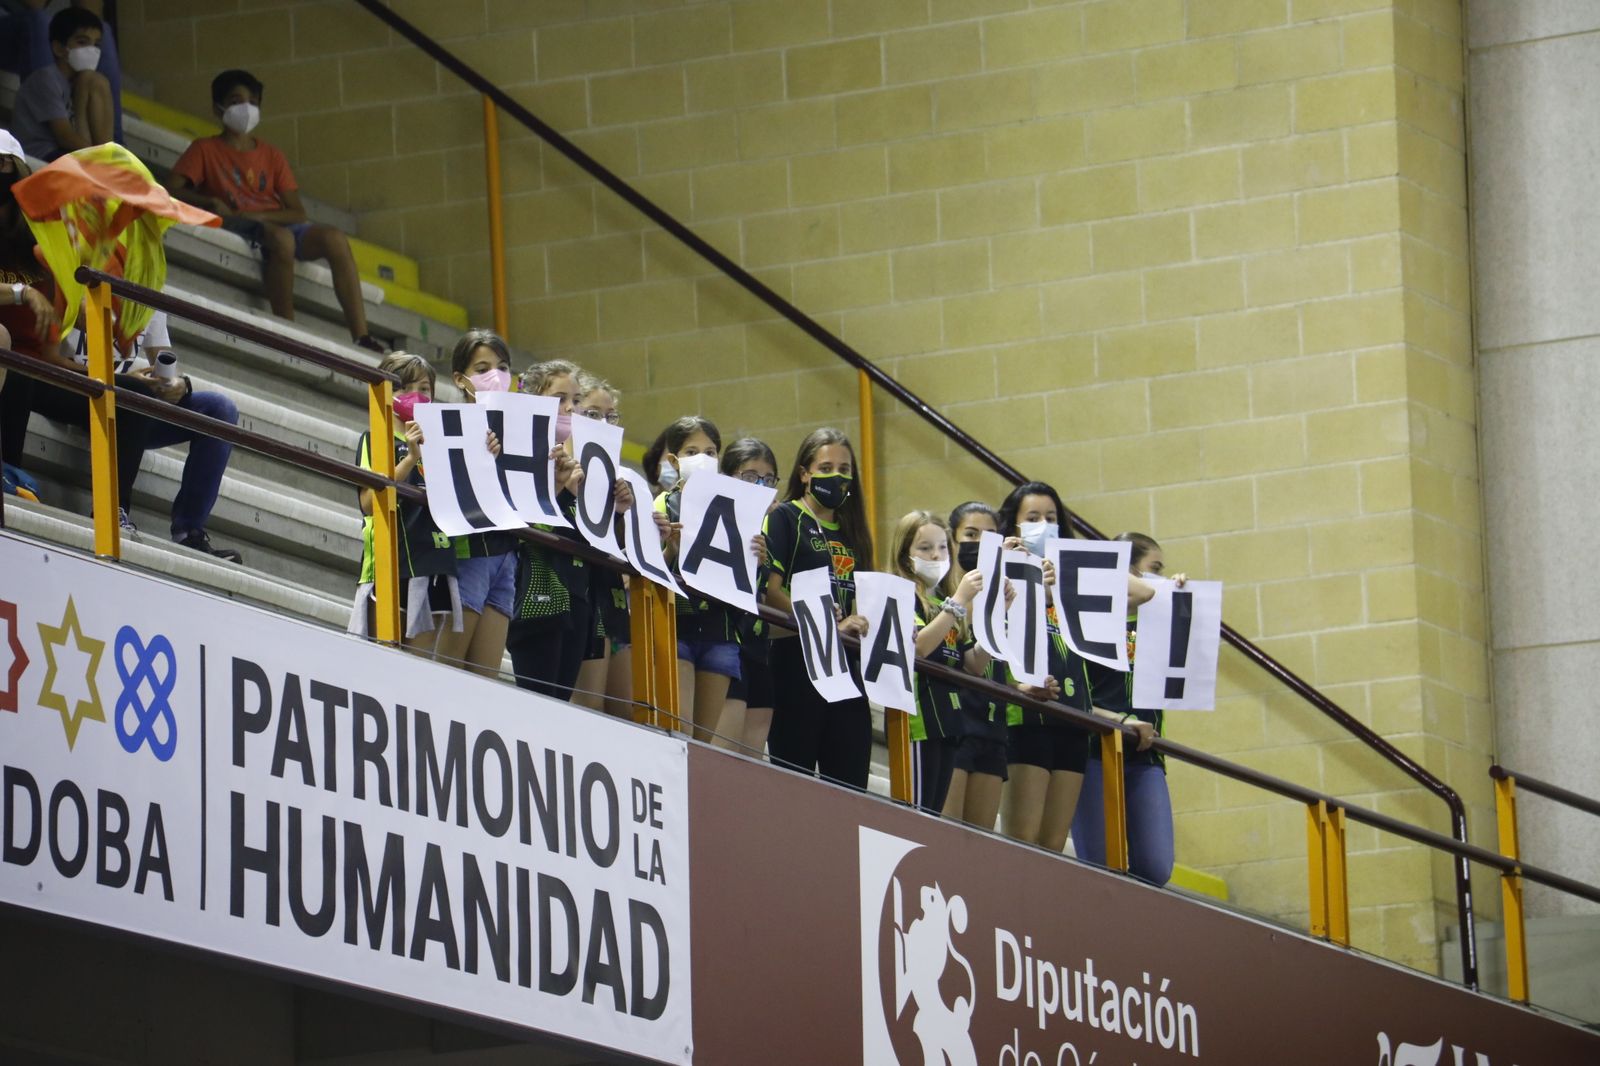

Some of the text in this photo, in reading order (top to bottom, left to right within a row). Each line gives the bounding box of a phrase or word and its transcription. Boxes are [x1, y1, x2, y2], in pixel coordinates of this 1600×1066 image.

[231, 656, 664, 868] PATRIMONIO DE
[1064, 677, 1075, 697] 6
[229, 790, 670, 1021] HUMANIDAD LA
[994, 928, 1199, 1058] Diputación
